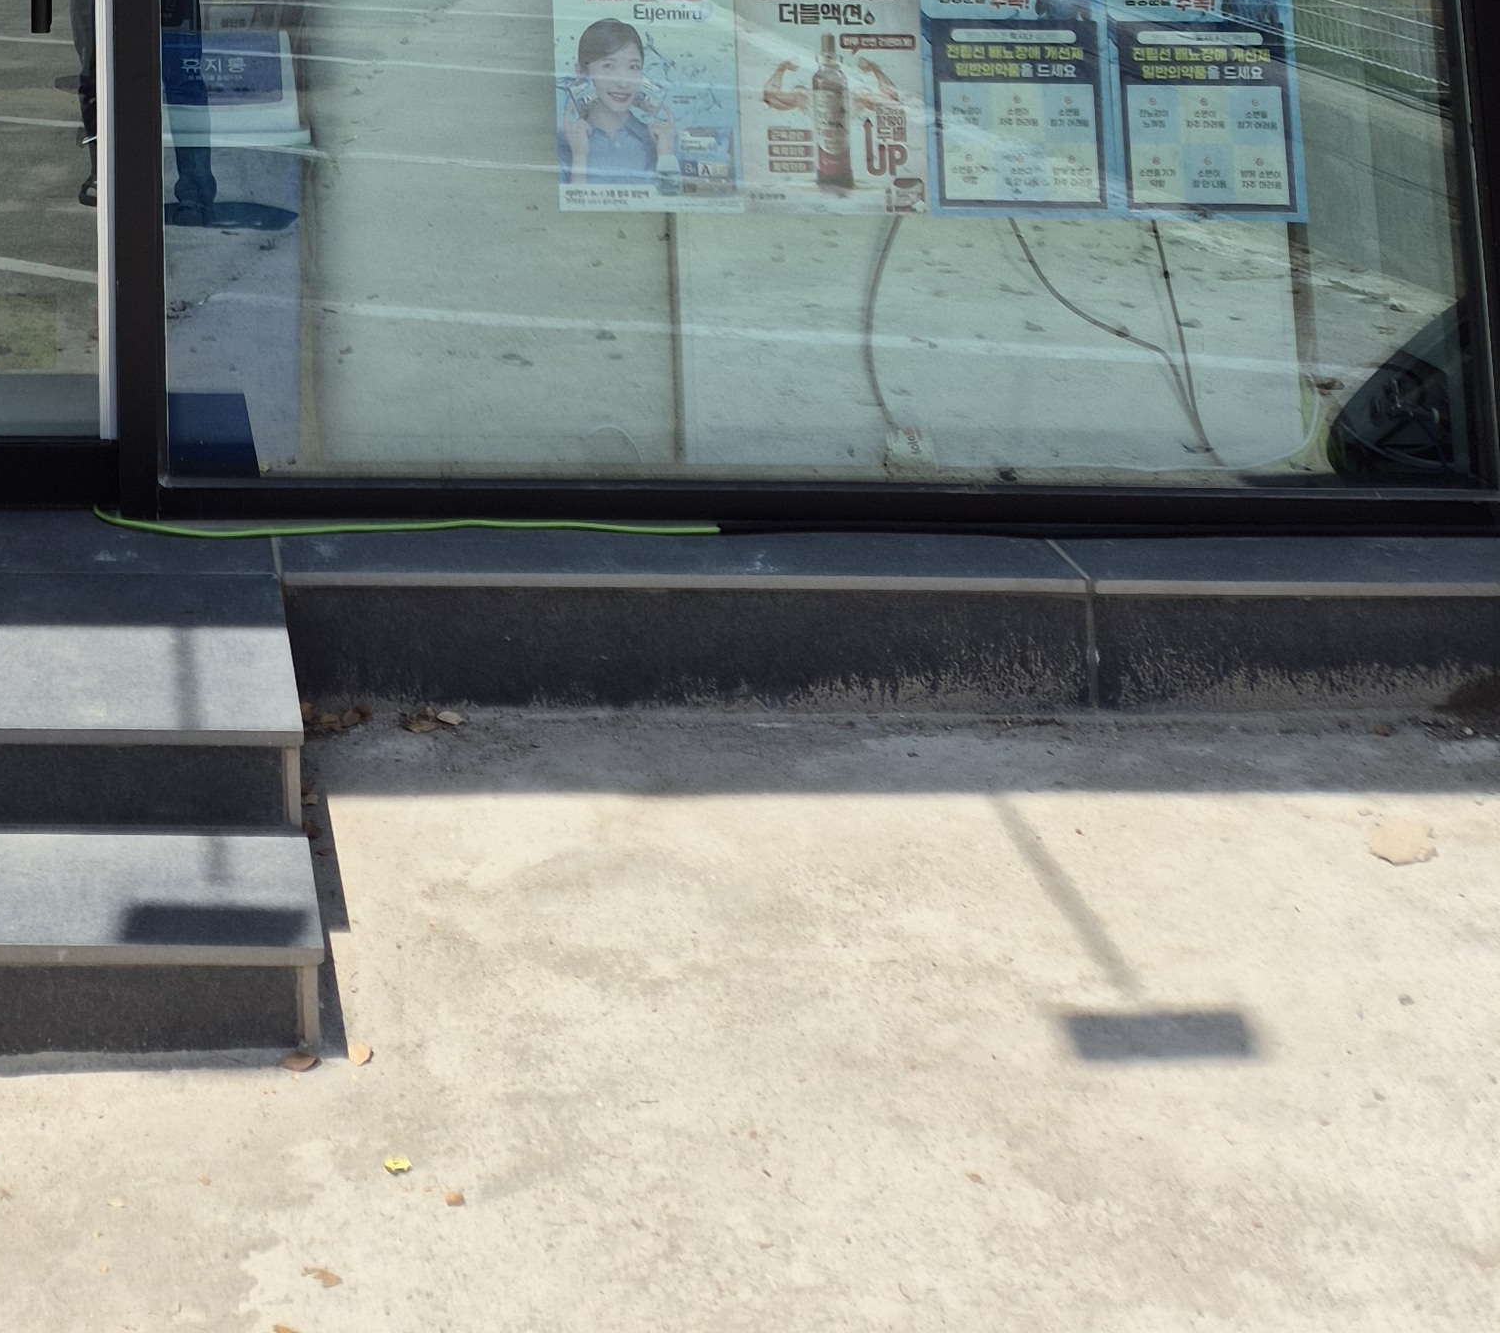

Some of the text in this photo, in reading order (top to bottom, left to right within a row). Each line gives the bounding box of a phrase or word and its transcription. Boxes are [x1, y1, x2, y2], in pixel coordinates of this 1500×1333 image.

[633, 3, 702, 24] Eyemiru
[778, 3, 864, 25] 더블액션
[946, 44, 986, 60] 전립선
[1132, 47, 1171, 62] 전립선
[181, 56, 247, 74] 휴지통
[955, 62, 1077, 78] 일반의약품을 드세요
[1142, 65, 1264, 80] 일반의약품을 드세요
[865, 139, 908, 177] UP
